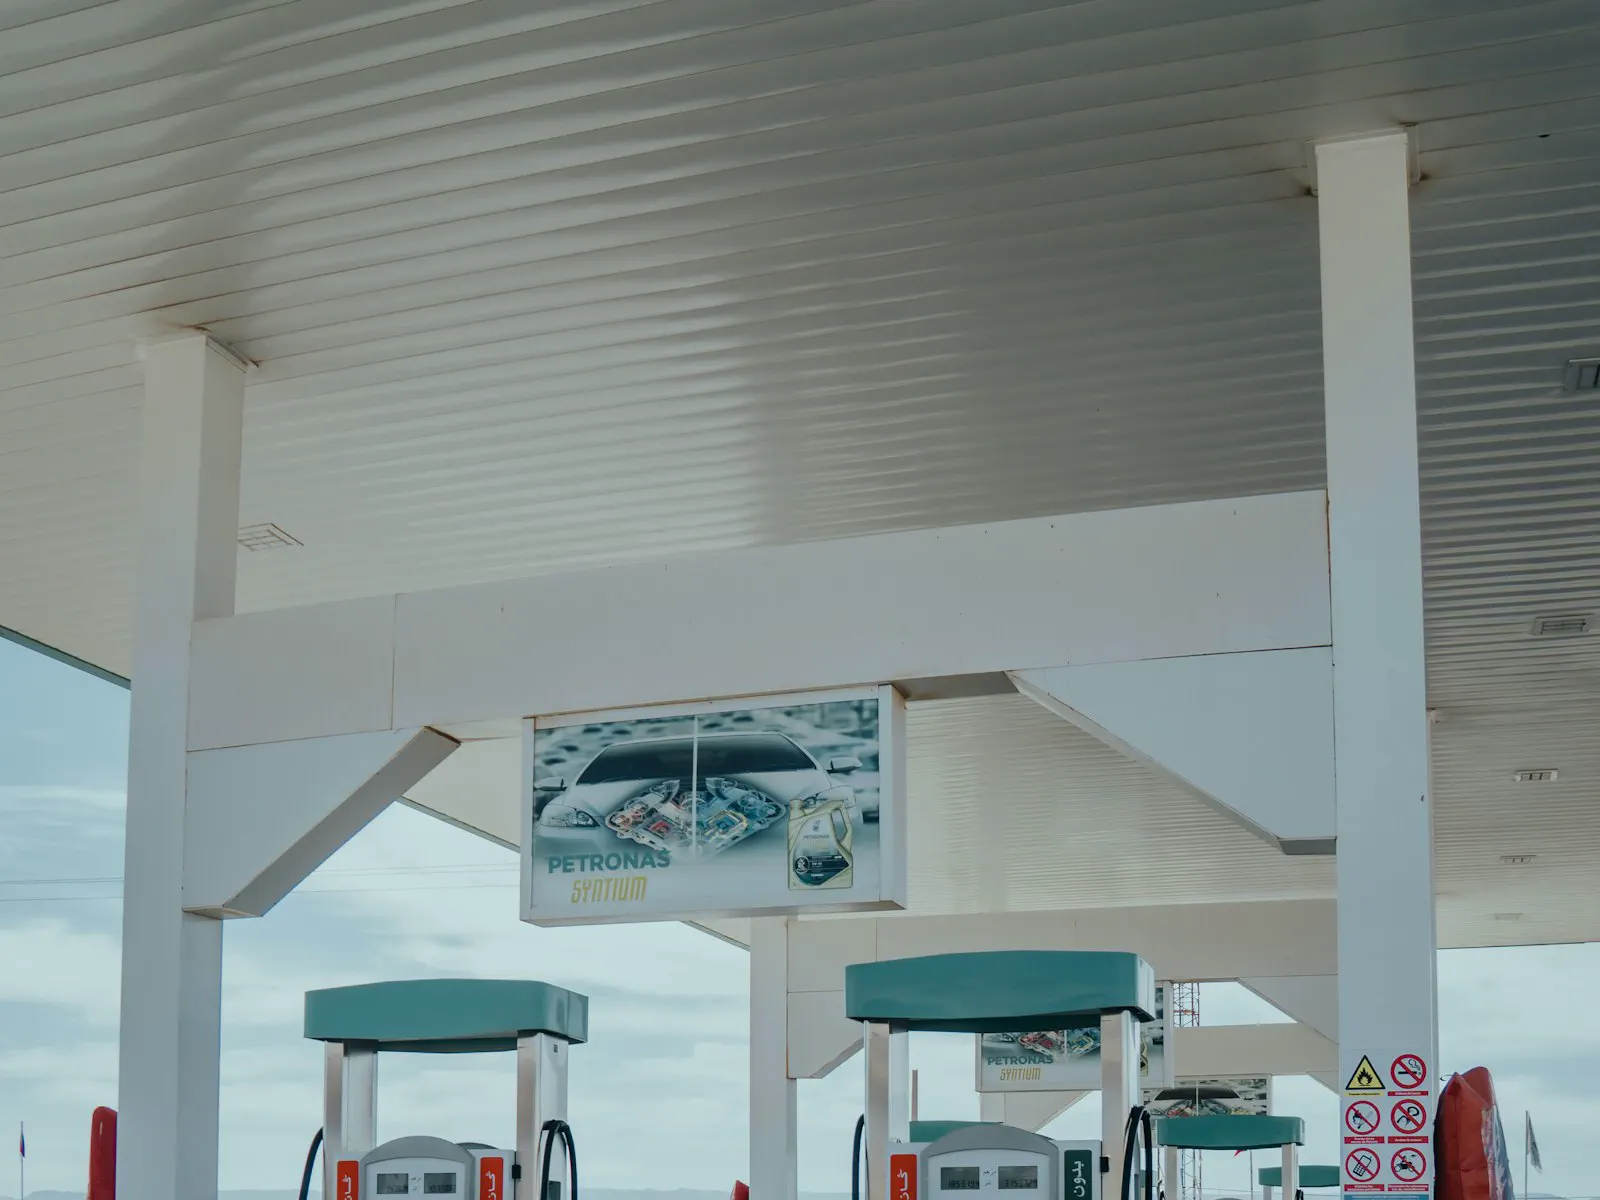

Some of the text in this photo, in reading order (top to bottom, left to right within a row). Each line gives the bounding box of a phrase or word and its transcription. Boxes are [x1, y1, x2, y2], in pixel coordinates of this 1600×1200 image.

[548, 848, 671, 873] PETRONAS
[571, 876, 647, 904] SYNTIUM
[987, 1055, 1053, 1065] PETRONAS
[1000, 1067, 1041, 1081] SYNTIUM
[1072, 1161, 1086, 1197] بدون
